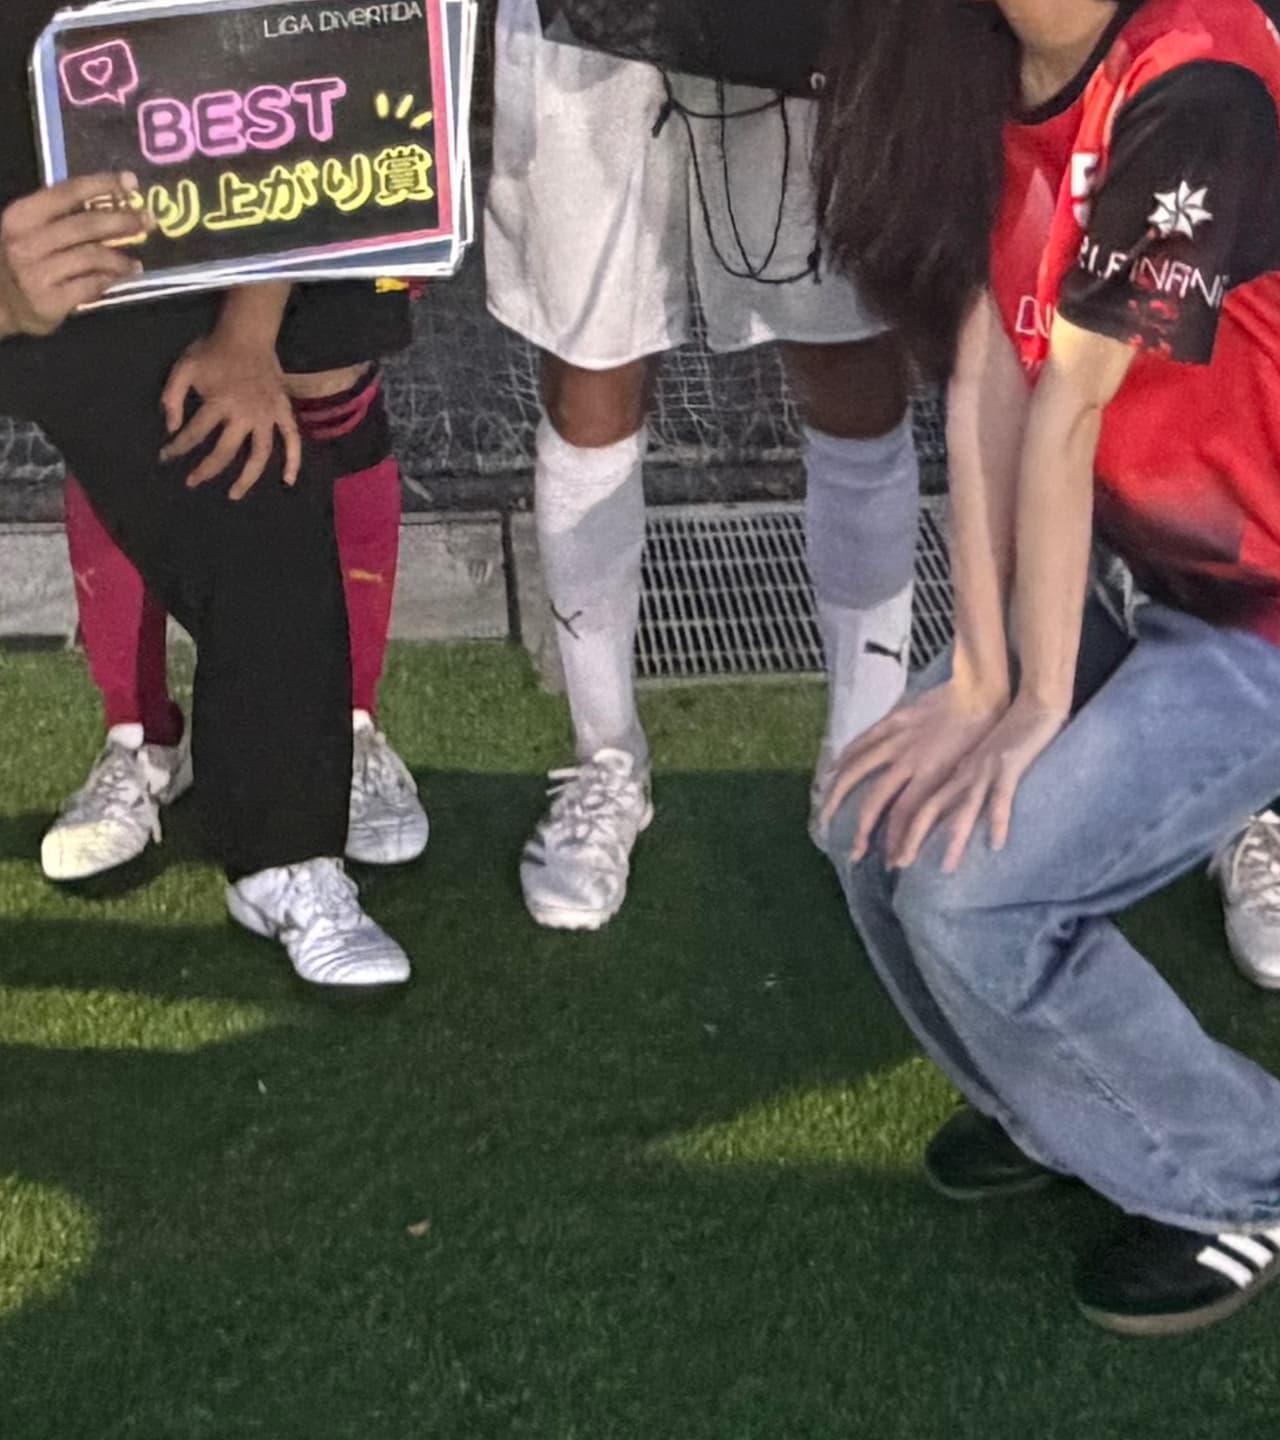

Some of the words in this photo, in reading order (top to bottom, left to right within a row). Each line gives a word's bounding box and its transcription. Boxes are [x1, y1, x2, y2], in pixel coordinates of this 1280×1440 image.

[137, 76, 347, 164] BEST
[84, 143, 433, 247] り上がり賞
